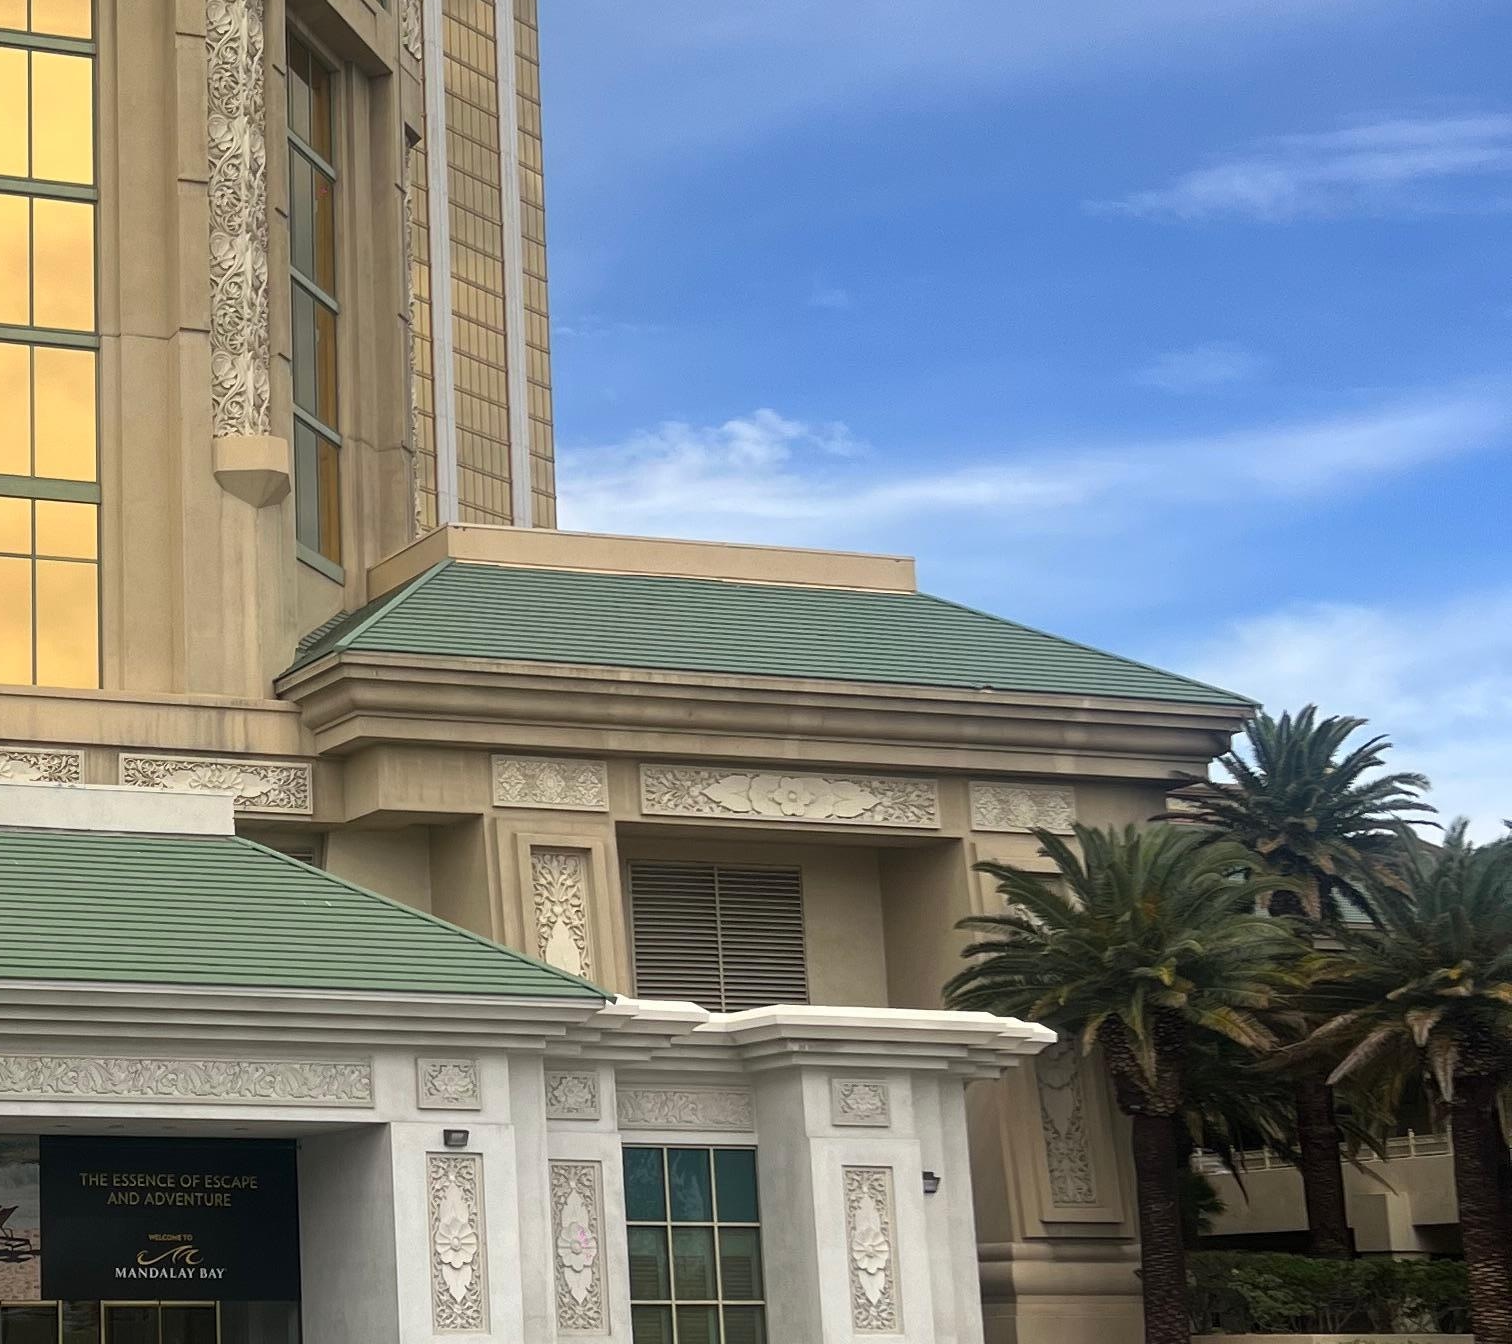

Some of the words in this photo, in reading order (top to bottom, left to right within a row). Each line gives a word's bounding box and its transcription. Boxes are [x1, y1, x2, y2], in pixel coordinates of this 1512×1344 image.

[79, 1172, 108, 1187] THE
[112, 1173, 176, 1188] ESSENCE
[180, 1174, 201, 1189] OF
[204, 1175, 259, 1189] ESCAPE
[107, 1191, 140, 1206] AND
[144, 1192, 232, 1207] ADVENTURE
[148, 1233, 182, 1242] WELCOME
[184, 1234, 193, 1242] TO
[115, 1267, 196, 1279] MANDALAY
[200, 1268, 225, 1279] BAY
